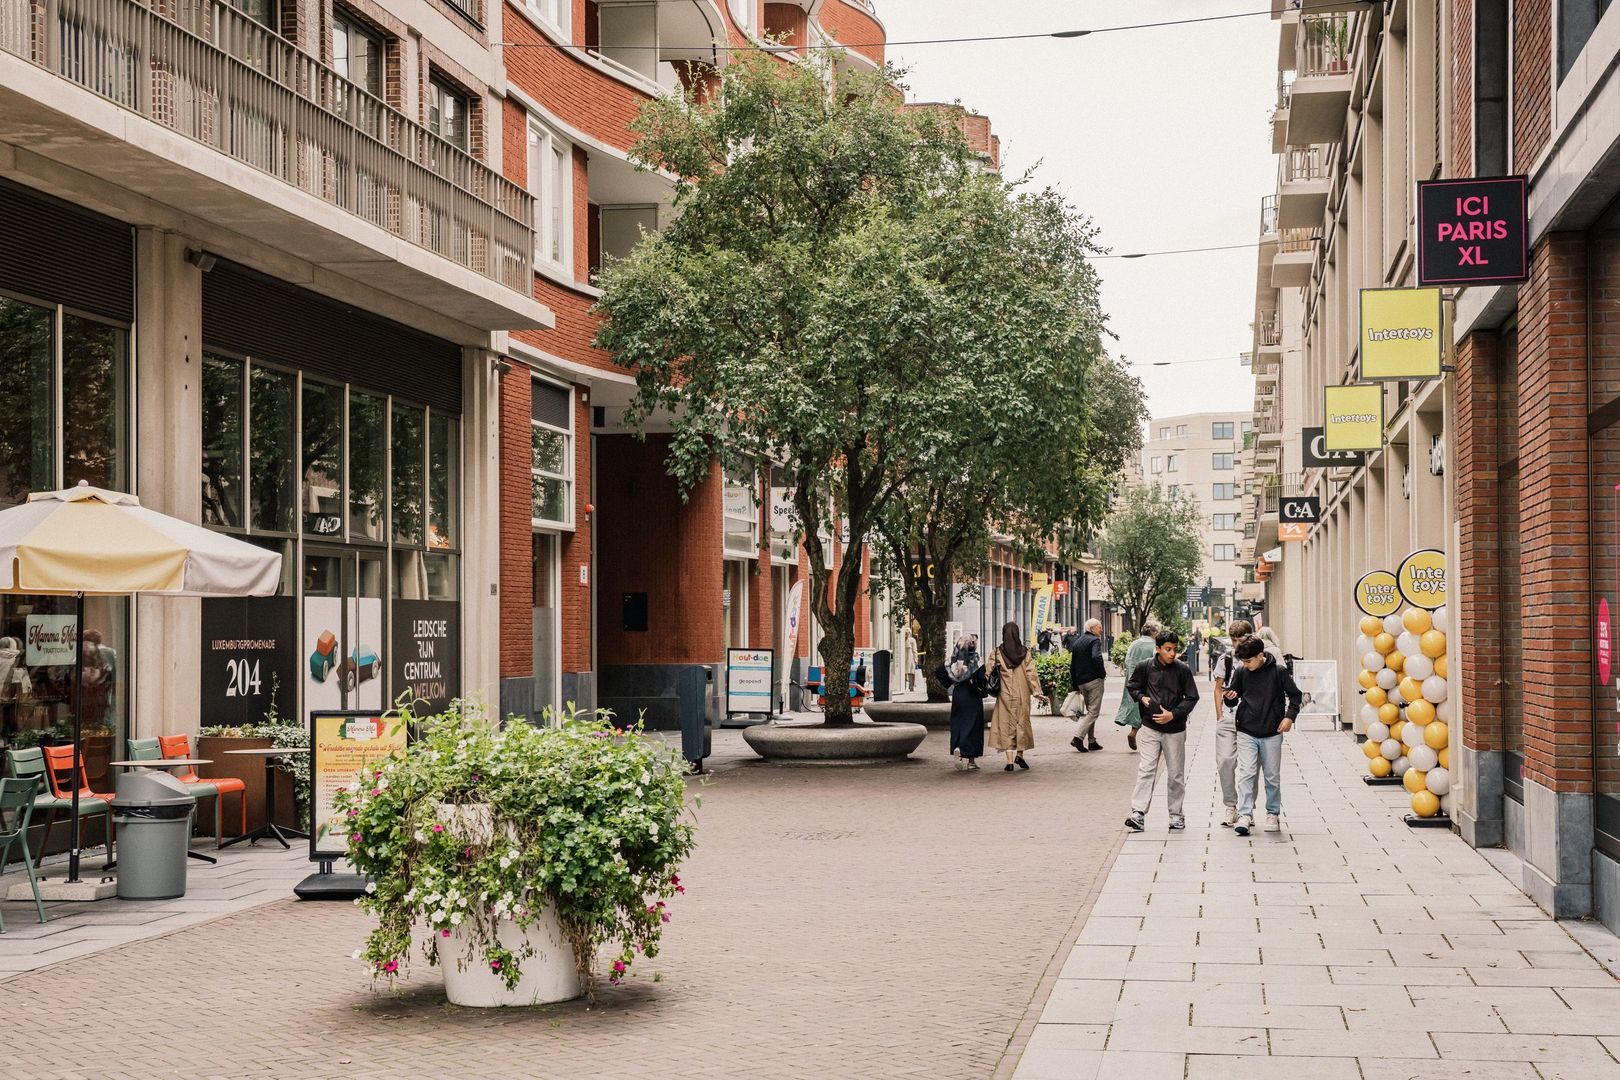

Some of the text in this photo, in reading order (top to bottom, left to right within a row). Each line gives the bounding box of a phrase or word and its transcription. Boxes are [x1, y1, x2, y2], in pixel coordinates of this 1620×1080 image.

[1456, 196, 1489, 216] ICI
[1438, 220, 1508, 242] PARIS
[1457, 246, 1489, 266] XL
[1368, 328, 1433, 341] Intertoys
[1330, 414, 1377, 424] Intertoys
[1284, 502, 1315, 518] C&A
[1364, 583, 1396, 594] Inter
[1412, 580, 1446, 595] toys
[1367, 594, 1394, 605] toys
[413, 620, 447, 637] LEIDSCHE
[28, 624, 60, 651] Mamma
[212, 640, 275, 650] LUXEMBURGPROMENADE
[417, 641, 434, 658] RIJN
[226, 659, 261, 697] 204
[404, 662, 442, 680] CENTRUM.
[414, 682, 446, 699] WELKOM
